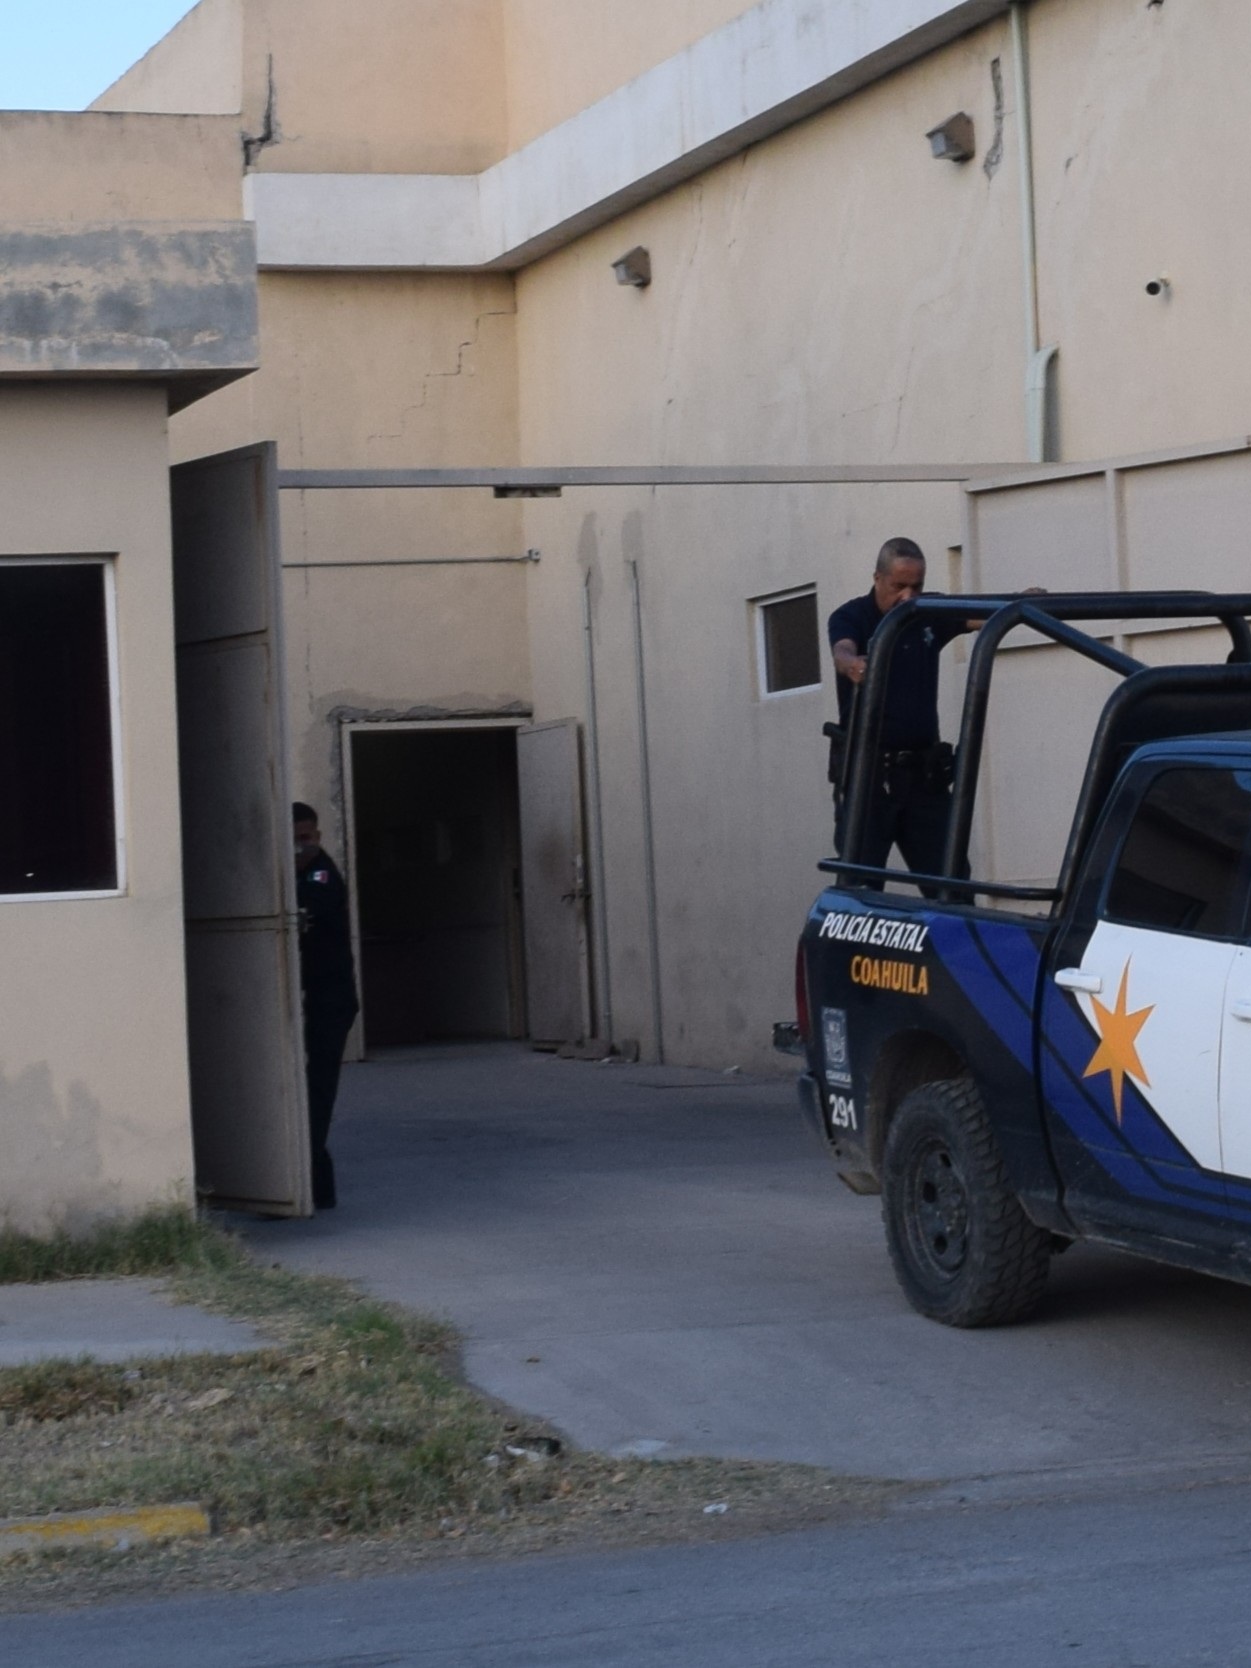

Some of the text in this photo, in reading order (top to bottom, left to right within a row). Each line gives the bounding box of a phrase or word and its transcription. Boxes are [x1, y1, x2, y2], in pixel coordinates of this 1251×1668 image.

[819, 912, 929, 952] POLICÍA ESTATAL
[851, 955, 929, 995] COAHUILA
[829, 1094, 858, 1130] 291
